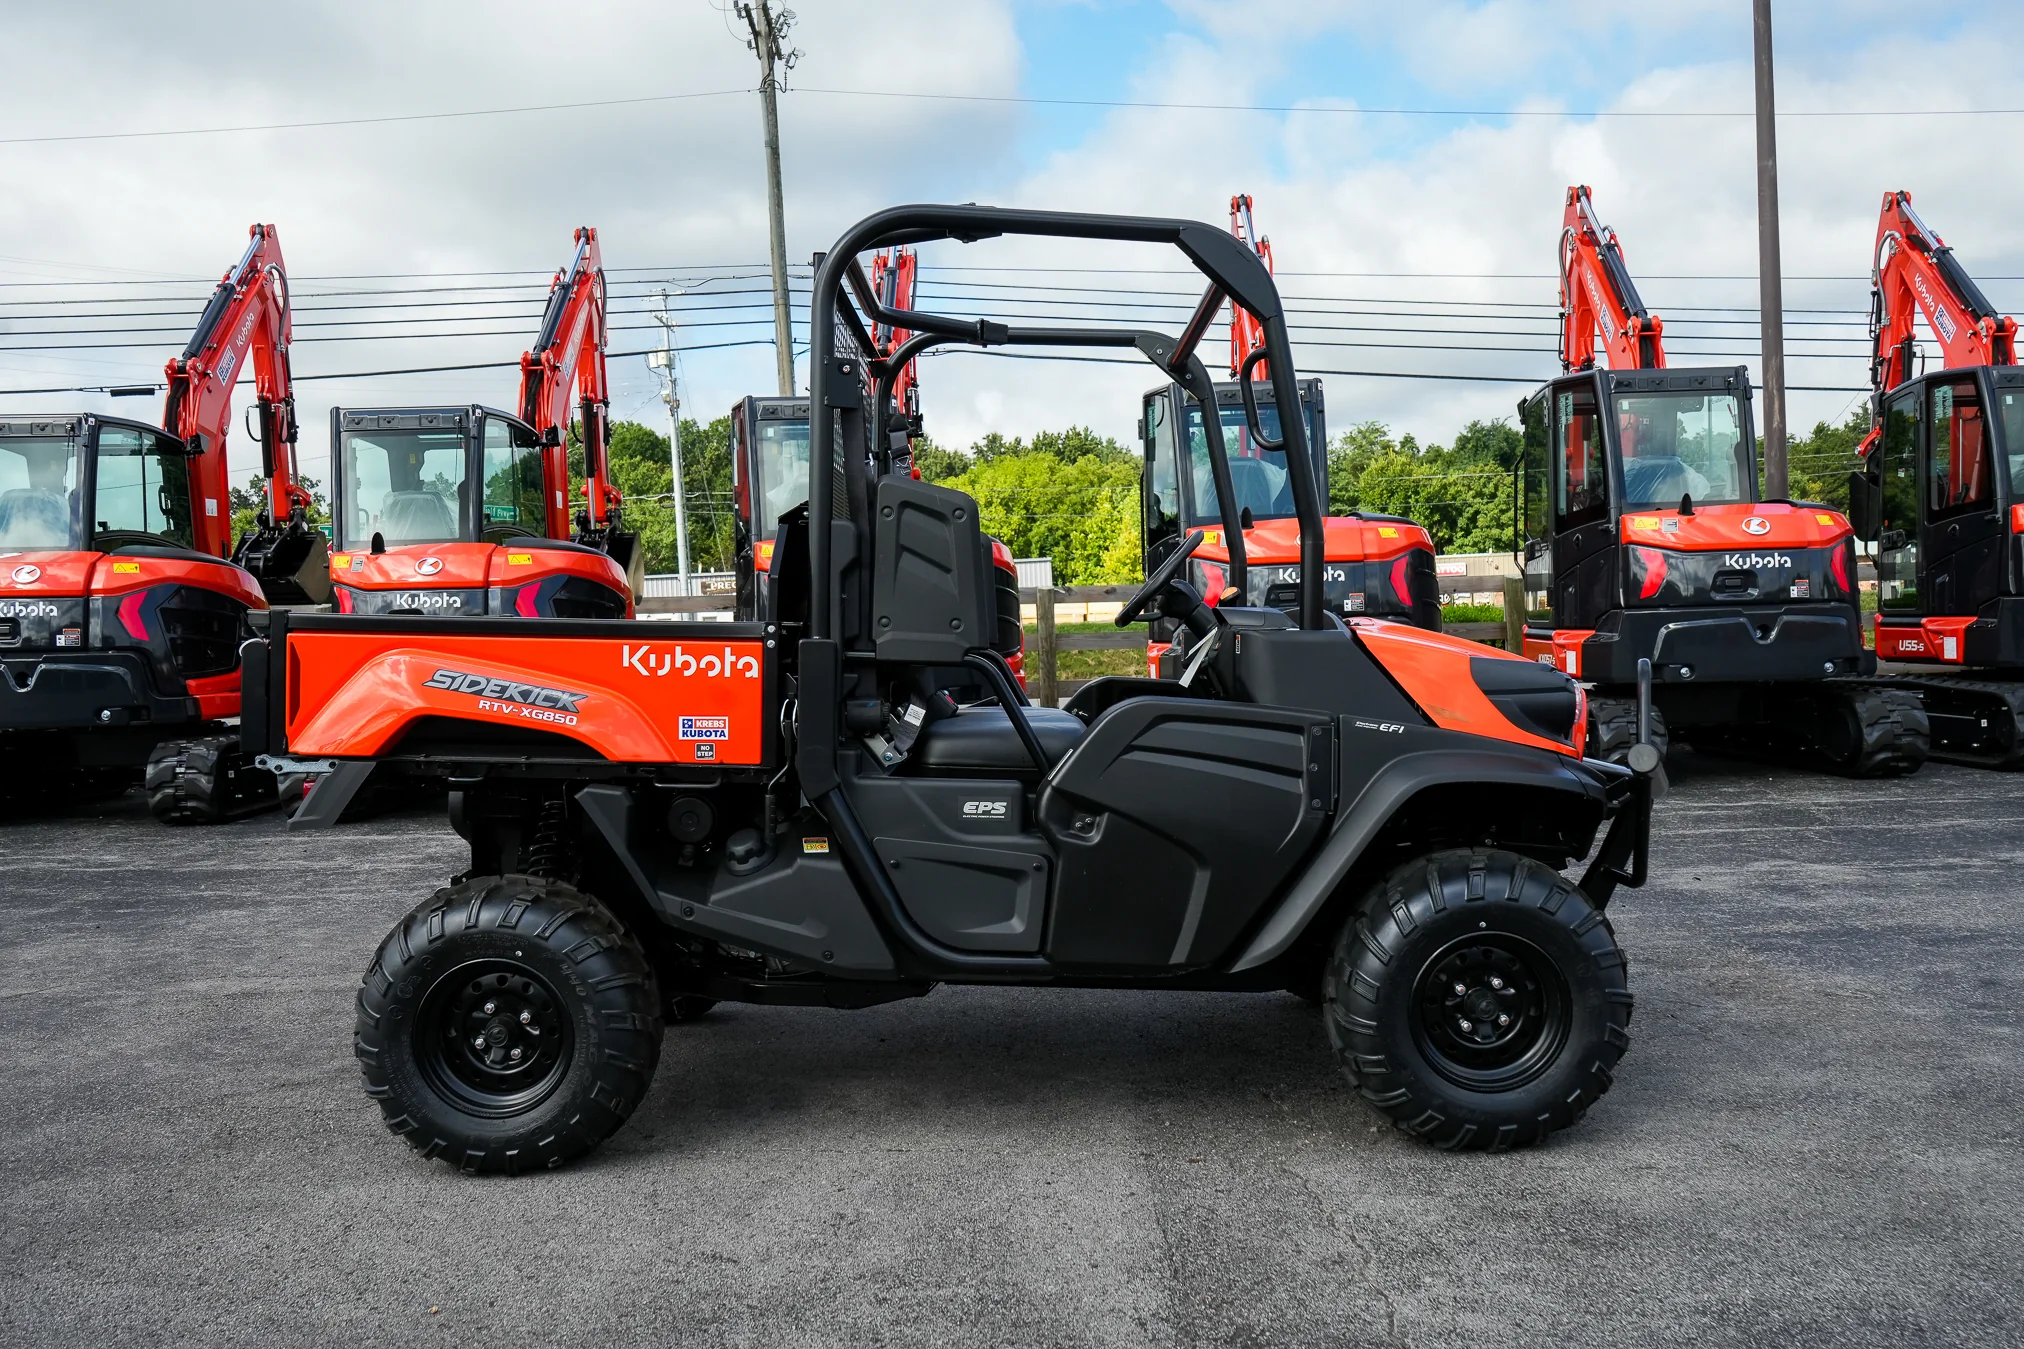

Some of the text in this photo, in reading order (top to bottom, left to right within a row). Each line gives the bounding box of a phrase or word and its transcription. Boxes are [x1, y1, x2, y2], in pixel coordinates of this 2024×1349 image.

[1914, 272, 1935, 312] Kubota
[235, 312, 255, 348] Kubota
[1725, 553, 1791, 569] Kubota
[396, 592, 461, 608] Kubota
[1899, 640, 1924, 651] U55-5
[623, 645, 758, 678] Kubota
[423, 669, 588, 713] SIDEKICK
[478, 699, 578, 726] RTV-XG850
[696, 720, 725, 728] KREBS
[1380, 723, 1404, 733] EFI
[682, 730, 726, 738] KUBOTA
[963, 801, 1007, 814] EPS
